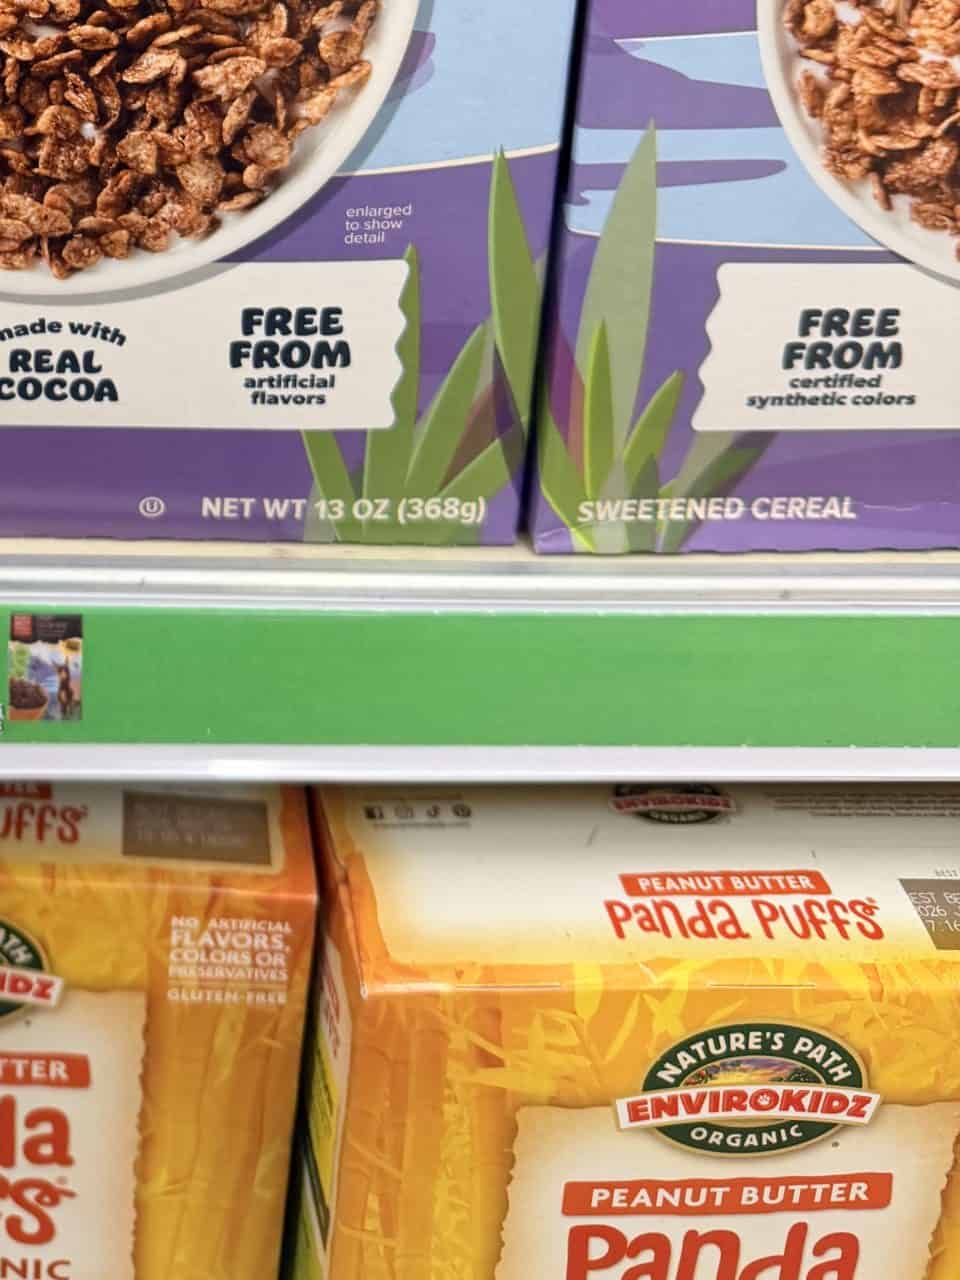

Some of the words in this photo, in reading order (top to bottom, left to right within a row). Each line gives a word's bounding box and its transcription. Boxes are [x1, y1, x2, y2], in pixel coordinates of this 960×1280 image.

[346, 203, 412, 219] enlarged
[345, 220, 359, 231] to
[363, 219, 403, 230] show
[344, 231, 385, 244] detail
[241, 306, 344, 337] FREE
[798, 307, 901, 338] FREE
[68, 321, 128, 348] with
[9, 349, 103, 376] REAL
[229, 339, 352, 370] FROM
[781, 340, 903, 370] FROM
[243, 372, 336, 391] artificial
[788, 373, 882, 390] certified
[250, 389, 327, 406] flavors
[746, 391, 847, 408] synthetic
[851, 391, 916, 406] colors
[201, 497, 256, 518] NET
[262, 498, 306, 519] WT
[314, 499, 345, 520] 13
[352, 498, 389, 520] OZ
[397, 496, 486, 524] (368g)
[578, 497, 744, 521] SWEETENED
[751, 497, 857, 520] CEREAL
[639, 875, 728, 892] PEANUT
[734, 873, 815, 891] BUTTER
[208, 918, 291, 934] ARTIFICIAL
[171, 929, 291, 954] FLAVORS,
[170, 948, 252, 963] COLORS
[255, 951, 286, 966] OR
[168, 966, 288, 983] PRESERVATIVES
[167, 988, 287, 1007] GLUTEN-FREE
[656, 1031, 785, 1083] NATURE'S
[792, 1037, 852, 1082] PATH
[627, 1088, 873, 1123] ENVIROKIDZ
[690, 1124, 803, 1147] ORGANIC
[590, 1185, 724, 1209] PEANUT
[741, 1181, 869, 1206] BUTTER
